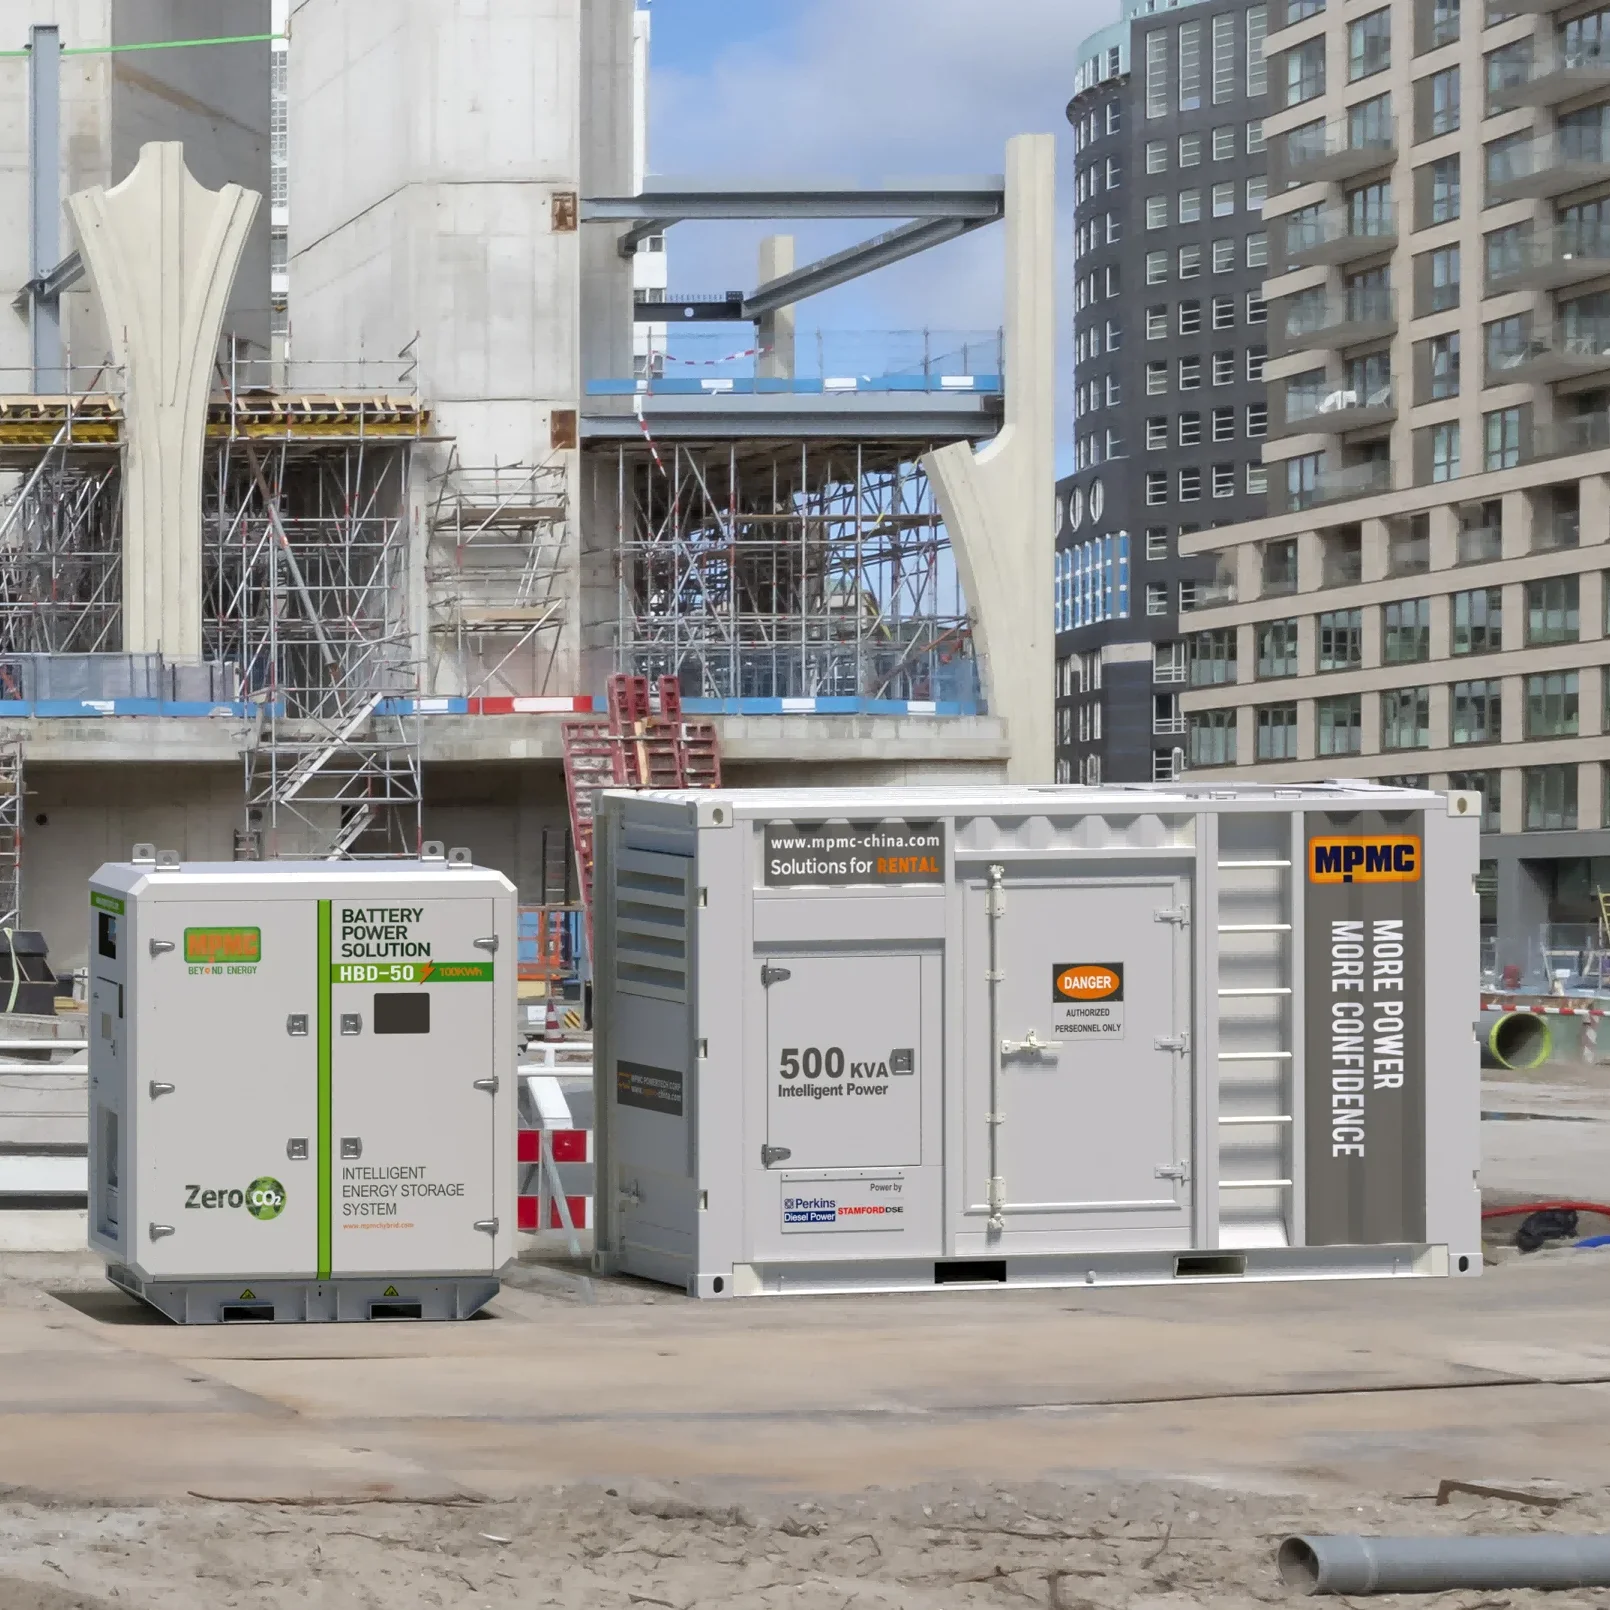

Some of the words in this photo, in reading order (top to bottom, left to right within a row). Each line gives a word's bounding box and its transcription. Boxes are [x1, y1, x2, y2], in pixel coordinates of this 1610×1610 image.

[771, 834, 940, 852] www.mpmc-china.com
[771, 858, 847, 875] Solutions
[849, 857, 873, 874] for
[877, 856, 939, 873] RENTAL
[1315, 844, 1415, 883] MPMC
[342, 908, 424, 923] BATTERY
[342, 925, 408, 940] POWER
[188, 934, 257, 963] MPMC
[341, 942, 431, 957] SOLUTION
[1373, 920, 1404, 991] MORE
[1332, 921, 1365, 992] MORE
[226, 966, 257, 974] ENERGY
[340, 965, 414, 981] HBD-50
[440, 967, 482, 977] 100KWh
[1064, 976, 1112, 989] DANGER
[1066, 1008, 1110, 1017] AUTHORIZED
[1055, 1024, 1101, 1032] PERSEONNEL
[1373, 1001, 1404, 1089] POWER
[779, 1047, 845, 1079] 500
[850, 1062, 889, 1078] KVA
[1332, 1002, 1365, 1157] CONFIDENCE
[778, 1084, 843, 1099] Intelligent
[846, 1083, 889, 1096] Power
[342, 1166, 426, 1180] INTELLIGENT
[342, 1184, 398, 1197] ENERGY
[401, 1183, 465, 1196] STORAGE
[870, 1183, 892, 1191] Power
[894, 1183, 902, 1192] by
[185, 1184, 244, 1209] Zero
[795, 1199, 836, 1209] Perkins
[342, 1202, 397, 1215] SYSTEM
[838, 1206, 885, 1215] STAMFORD
[784, 1214, 808, 1222] Diesel
[810, 1212, 835, 1221] Power
